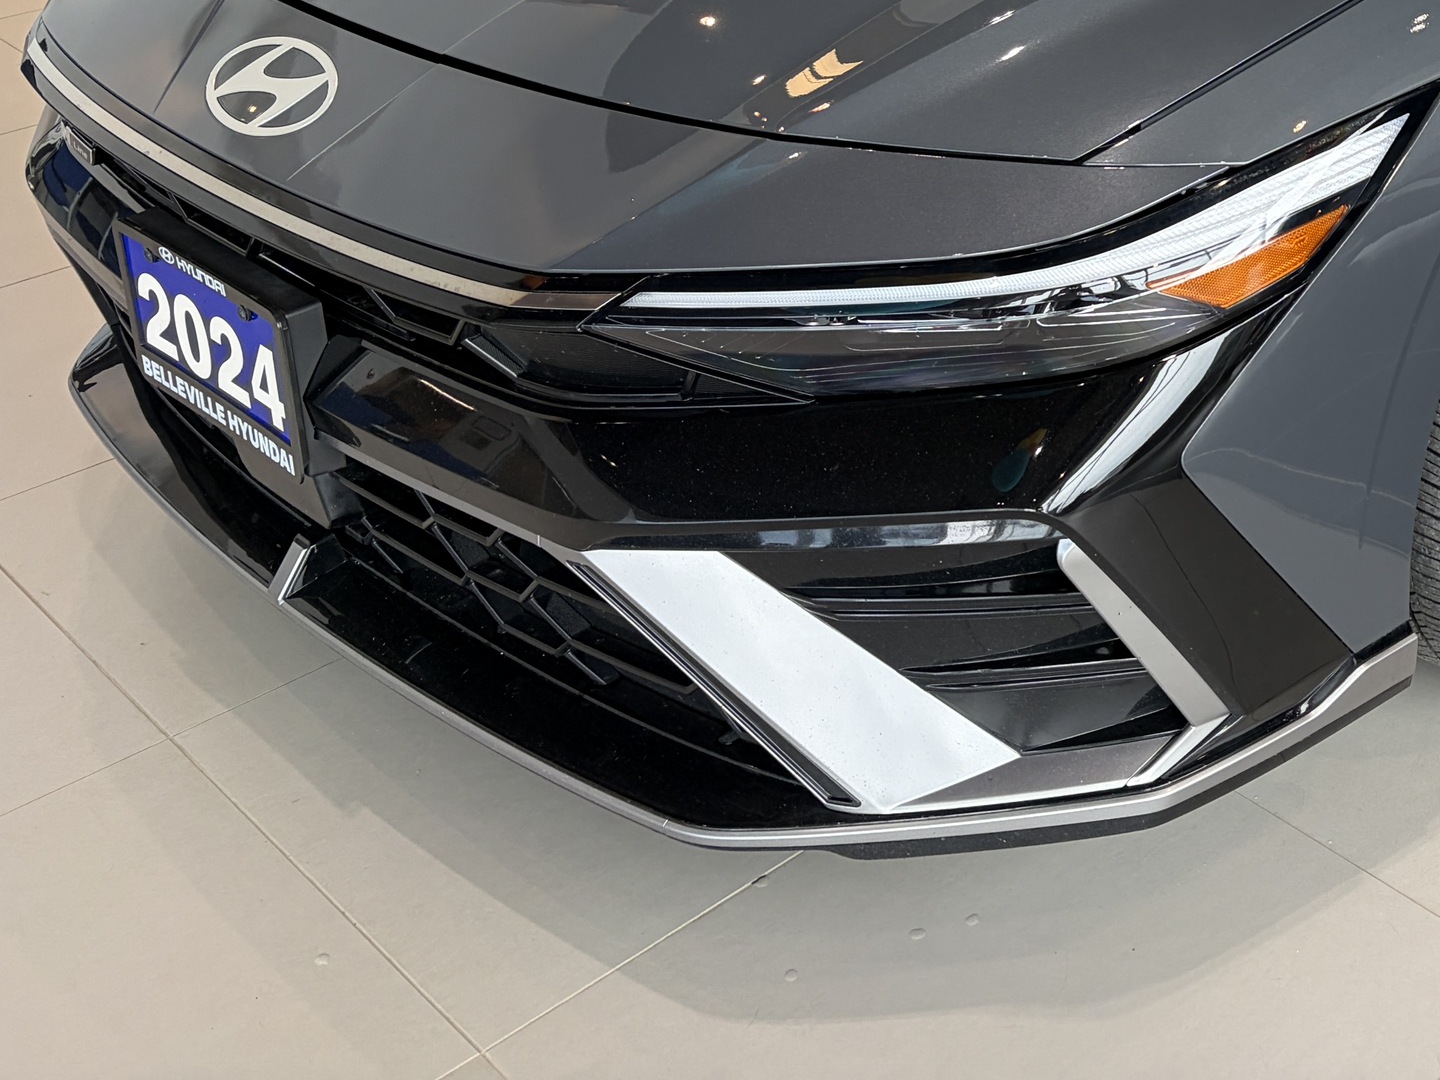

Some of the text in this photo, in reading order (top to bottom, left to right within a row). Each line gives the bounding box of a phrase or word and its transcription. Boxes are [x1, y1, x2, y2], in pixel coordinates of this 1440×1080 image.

[176, 256, 226, 297] HYUNDAI
[137, 272, 286, 432] 2024
[141, 354, 296, 477] BELLEVILLE HYUNDAI
